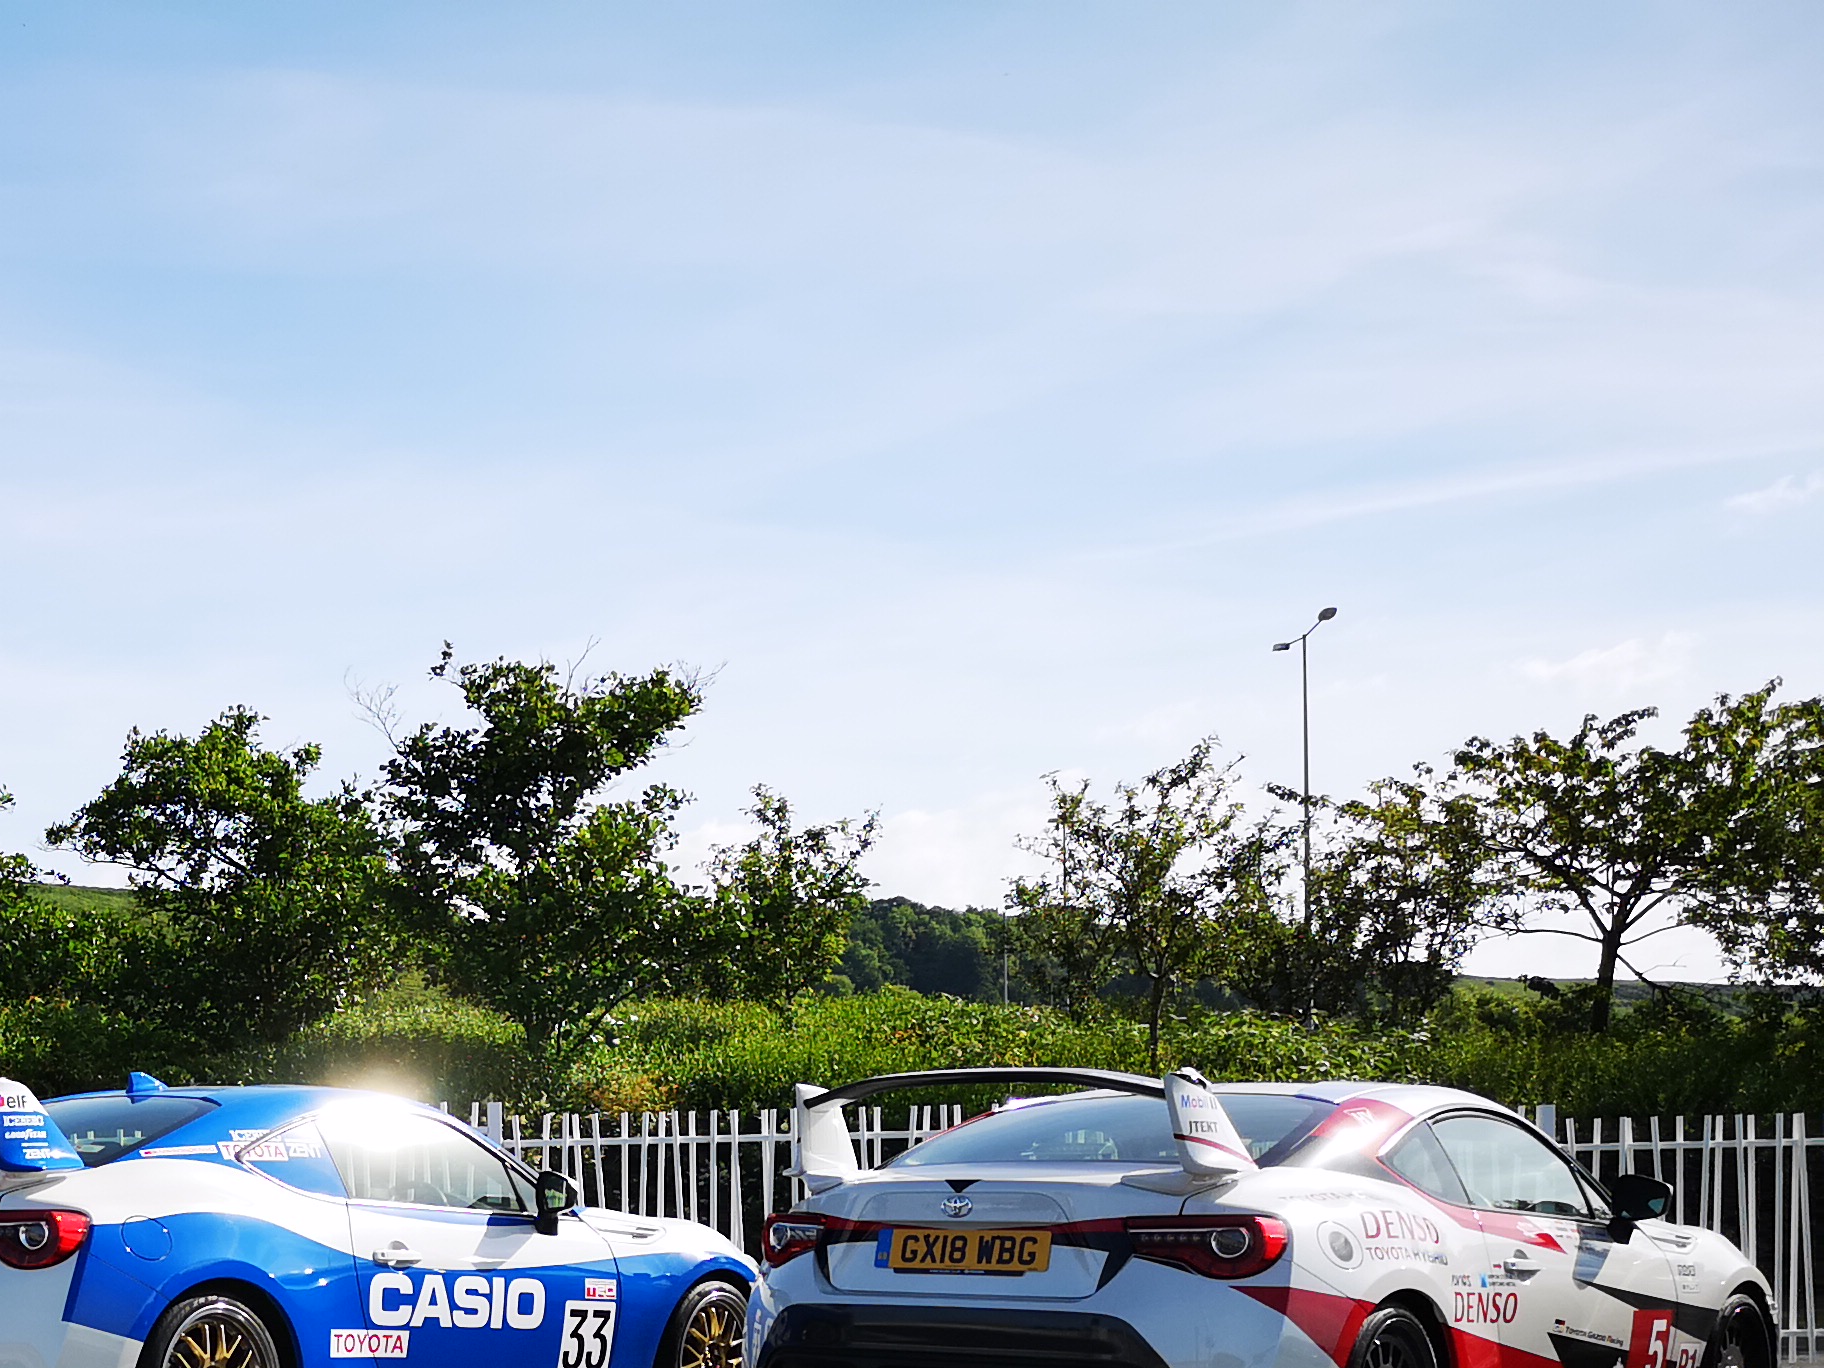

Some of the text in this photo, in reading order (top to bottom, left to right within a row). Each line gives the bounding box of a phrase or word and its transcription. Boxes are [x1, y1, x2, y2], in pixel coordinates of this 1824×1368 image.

[7, 1095, 27, 1109] elf
[1189, 1121, 1218, 1135] JTEKT
[1360, 1210, 1439, 1244] DENSO
[900, 1234, 1038, 1265] GX18 WBG
[369, 1272, 546, 1330] CASIO
[1454, 1292, 1518, 1323] DENSO
[334, 1333, 403, 1354] TOYOTA
